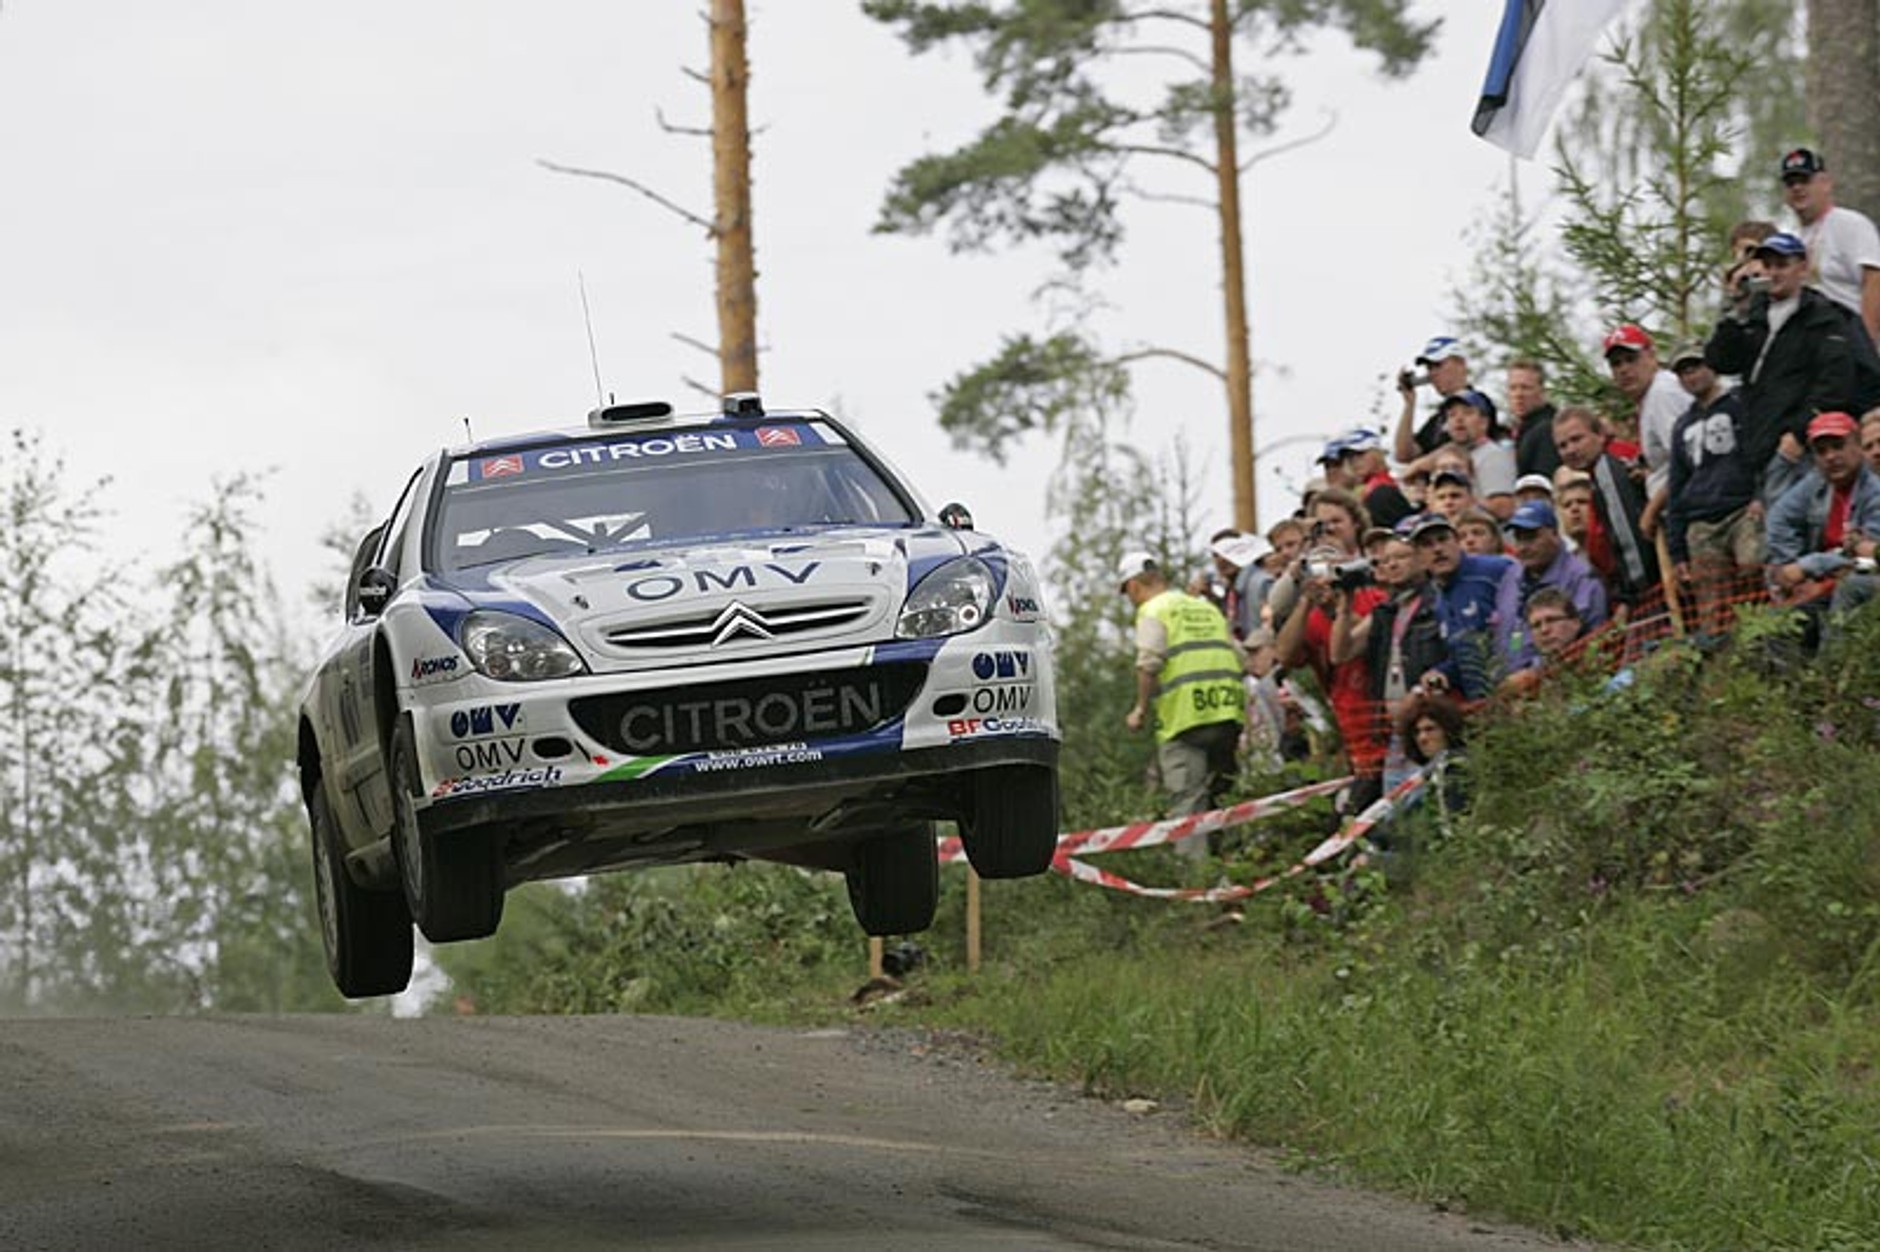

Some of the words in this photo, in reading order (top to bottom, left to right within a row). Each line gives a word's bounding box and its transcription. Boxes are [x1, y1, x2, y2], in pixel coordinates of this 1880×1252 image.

[538, 433, 737, 469] CITROËN
[627, 561, 822, 601] OMV
[972, 651, 1028, 680] OMV
[620, 678, 882, 749] CITROËN
[973, 686, 1031, 713] OMV
[451, 702, 520, 738] OMV
[456, 738, 526, 771] OMV
